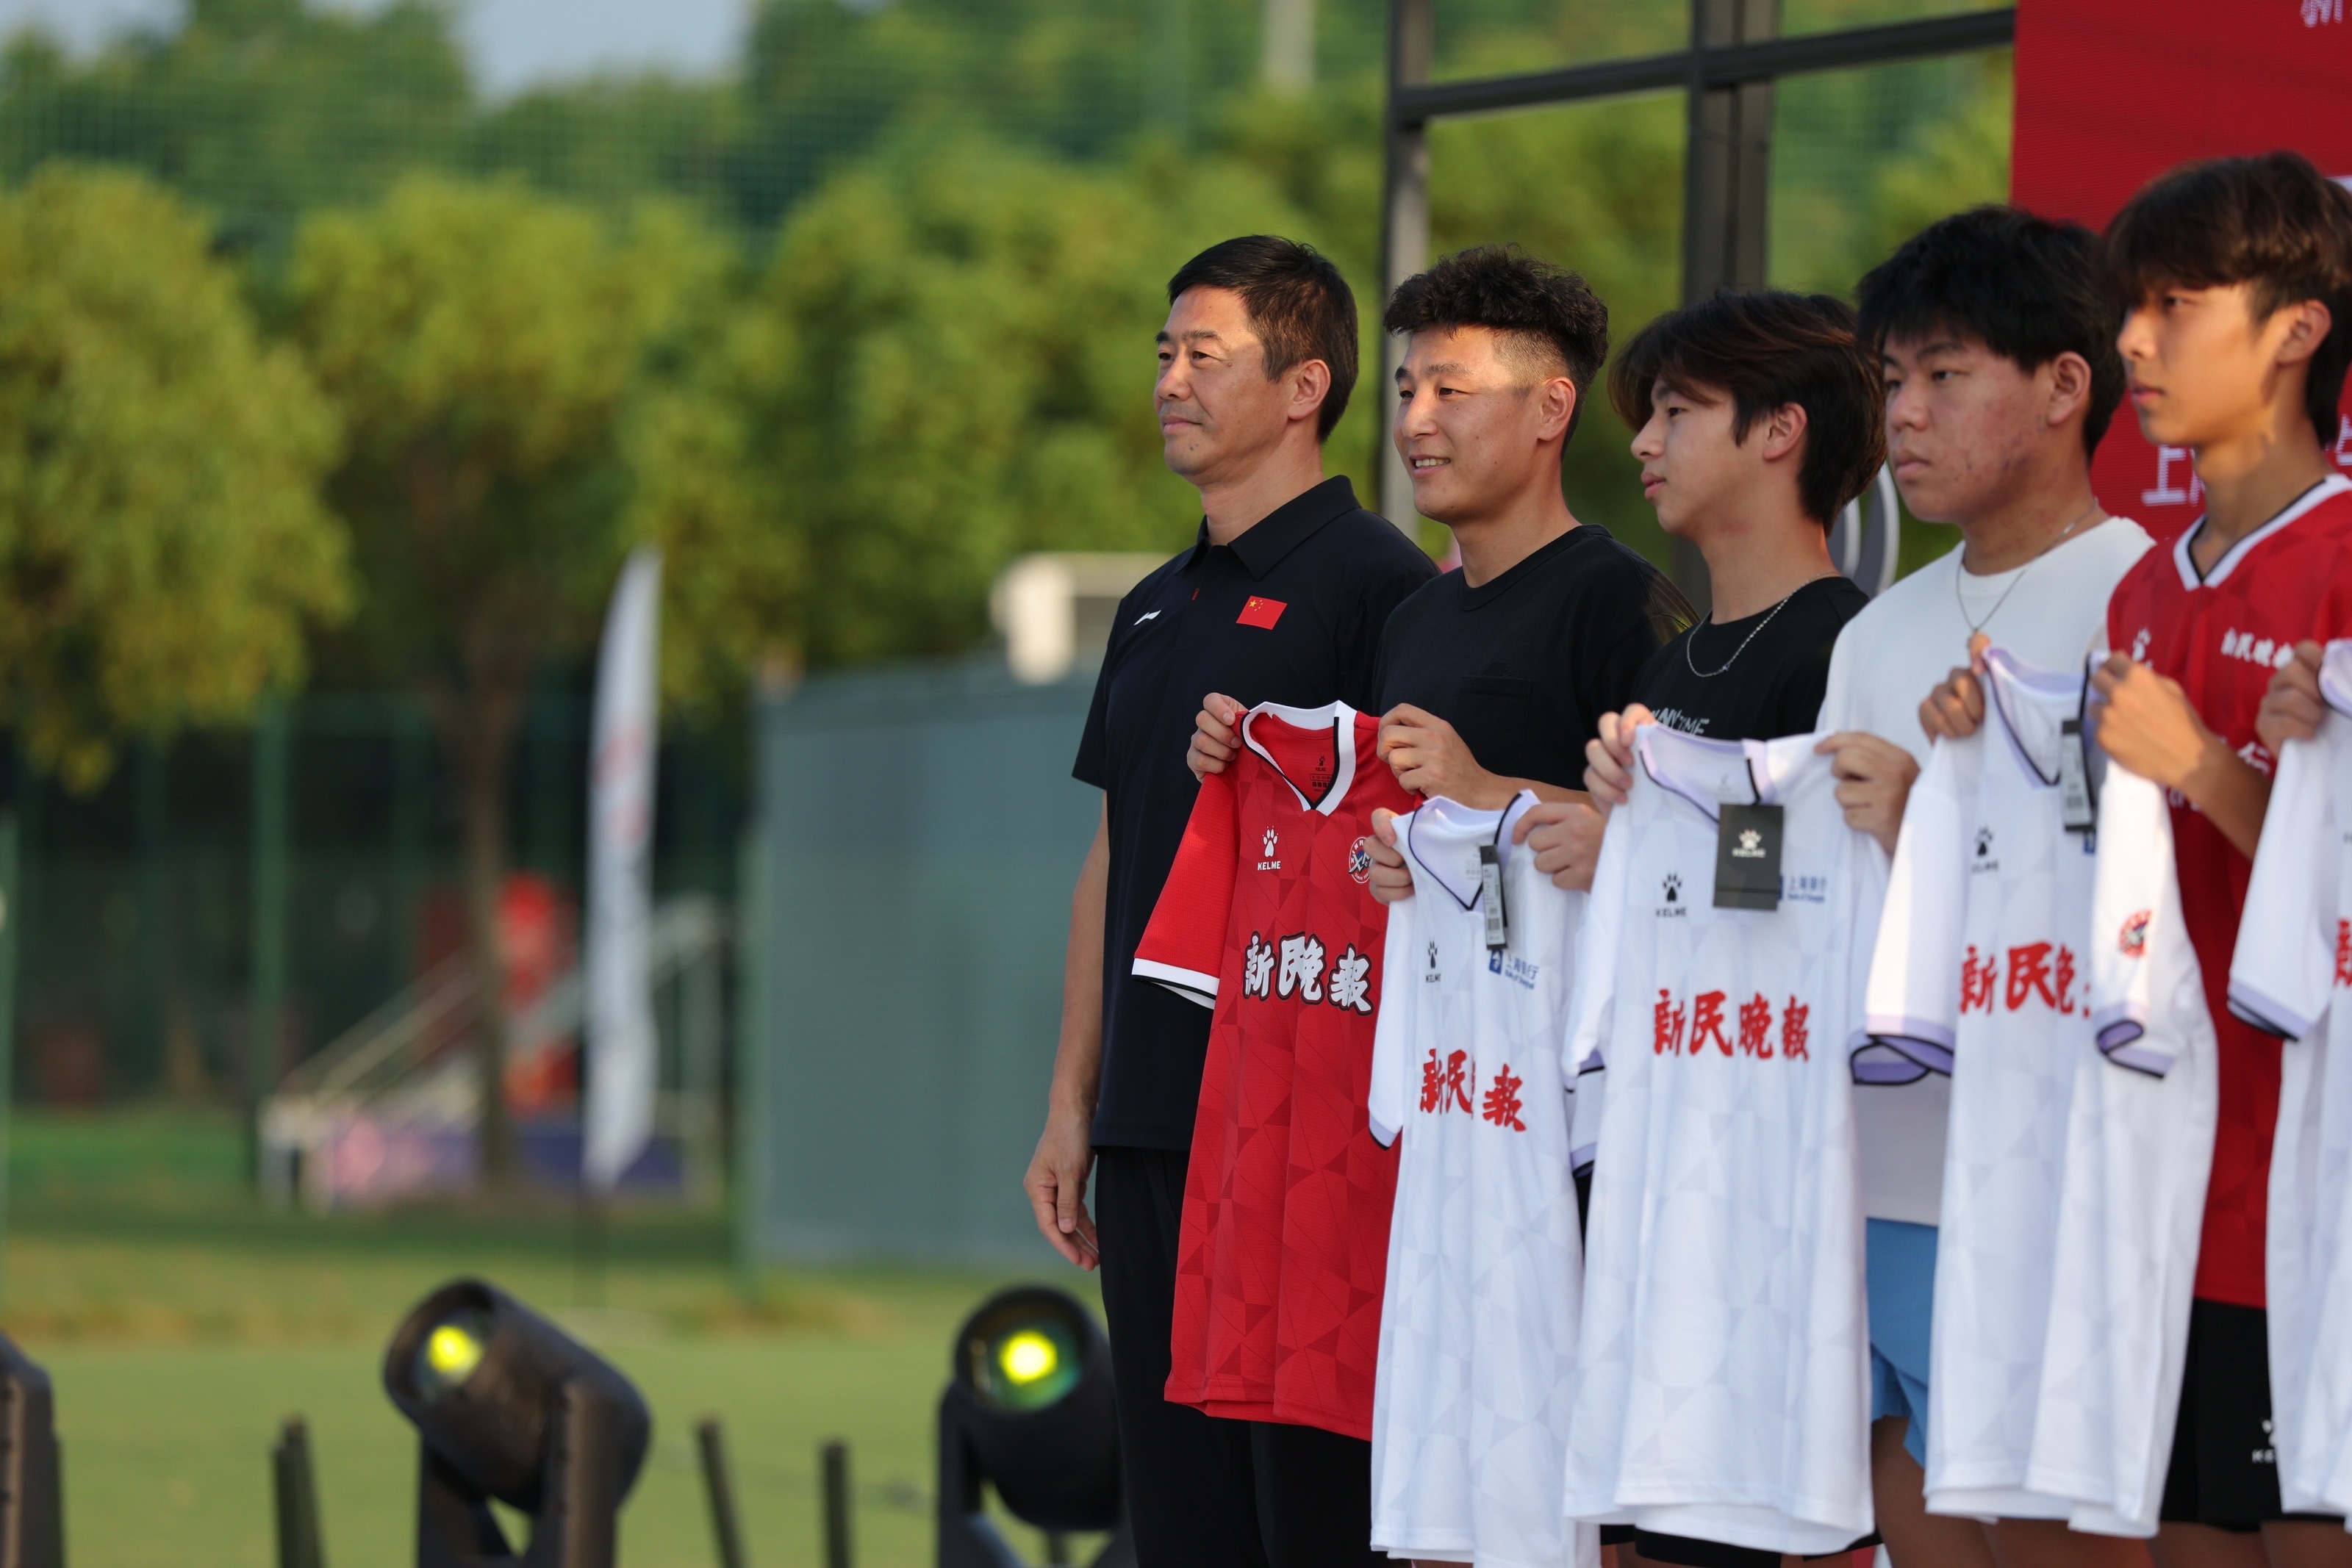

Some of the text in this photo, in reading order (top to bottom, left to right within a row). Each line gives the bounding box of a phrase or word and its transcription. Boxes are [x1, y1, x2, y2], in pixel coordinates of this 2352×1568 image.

[2140, 445, 2206, 507] 上
[1732, 847, 1766, 858] KELME
[1257, 860, 1281, 871] KELME
[1656, 907, 1686, 918] KELME
